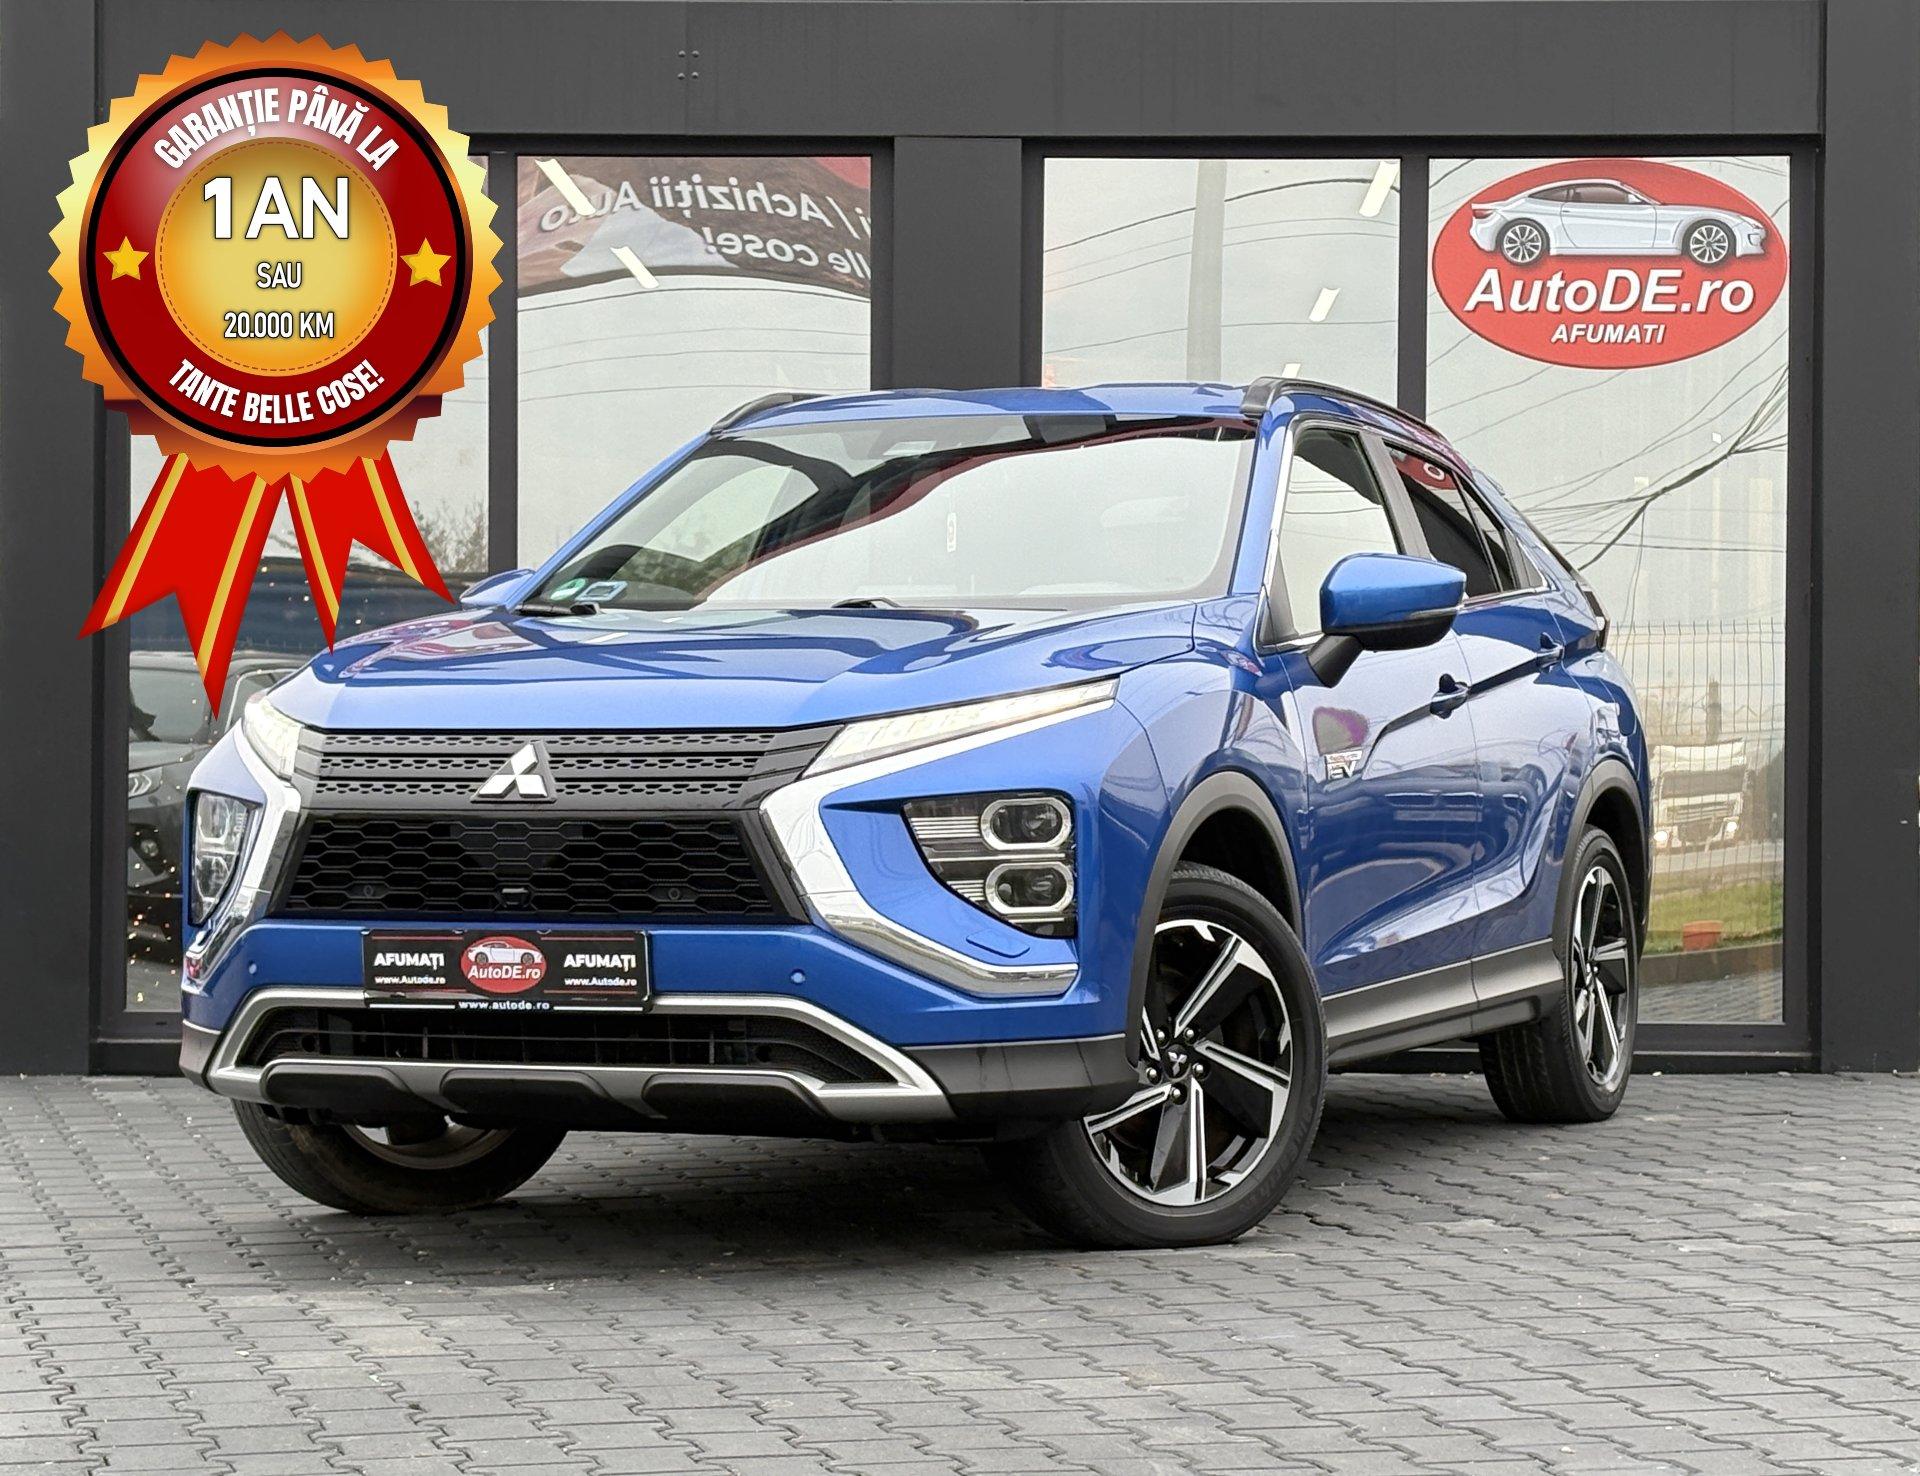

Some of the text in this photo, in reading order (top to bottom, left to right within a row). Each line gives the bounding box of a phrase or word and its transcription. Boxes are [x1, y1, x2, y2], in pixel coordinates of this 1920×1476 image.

[1463, 267, 1755, 313] AutoDE.ro
[1550, 323, 1666, 343] AFUMATI
[467, 965, 541, 980] AutoDE.ro
[458, 1000, 551, 1011] www.autode.ro
